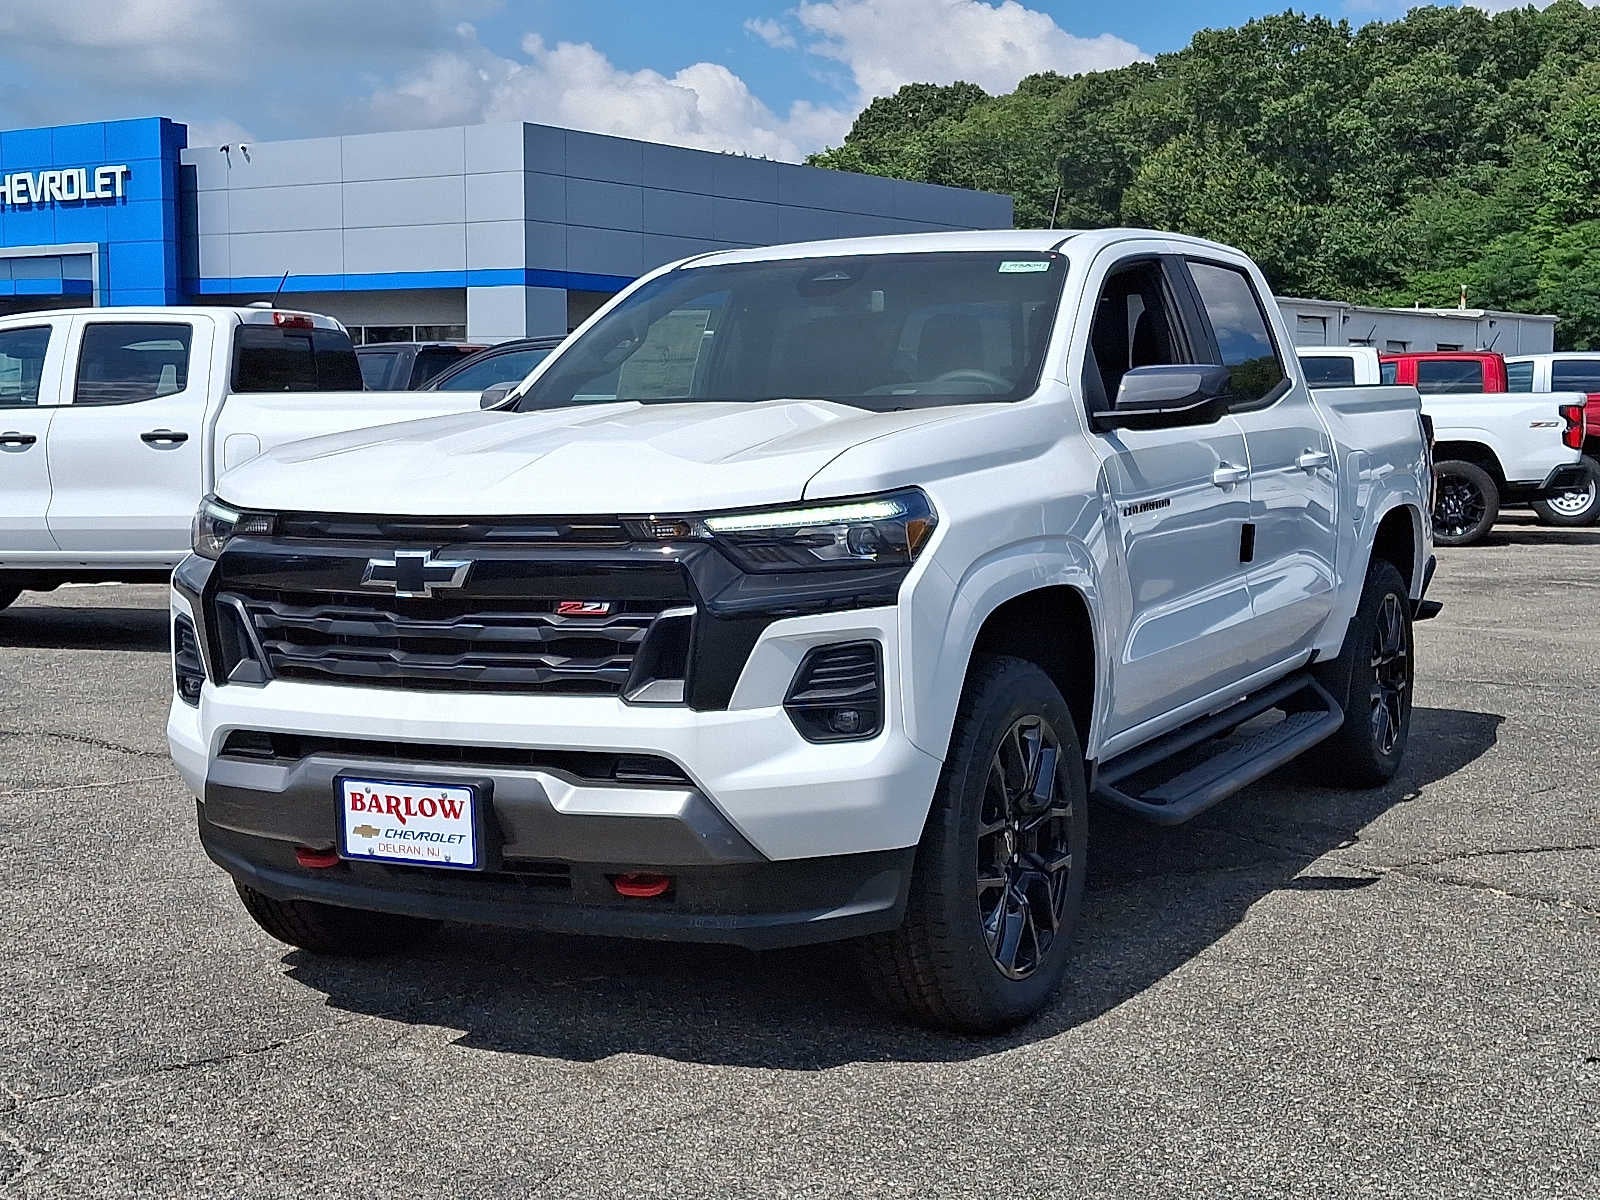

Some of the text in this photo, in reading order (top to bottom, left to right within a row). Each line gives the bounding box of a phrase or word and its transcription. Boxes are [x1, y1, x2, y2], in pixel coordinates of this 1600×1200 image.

[0, 165, 127, 204] HEVROLET
[350, 792, 465, 825] BARLOW
[385, 828, 466, 844] CHEVROLET
[378, 842, 440, 857] DELRAN, NJ
